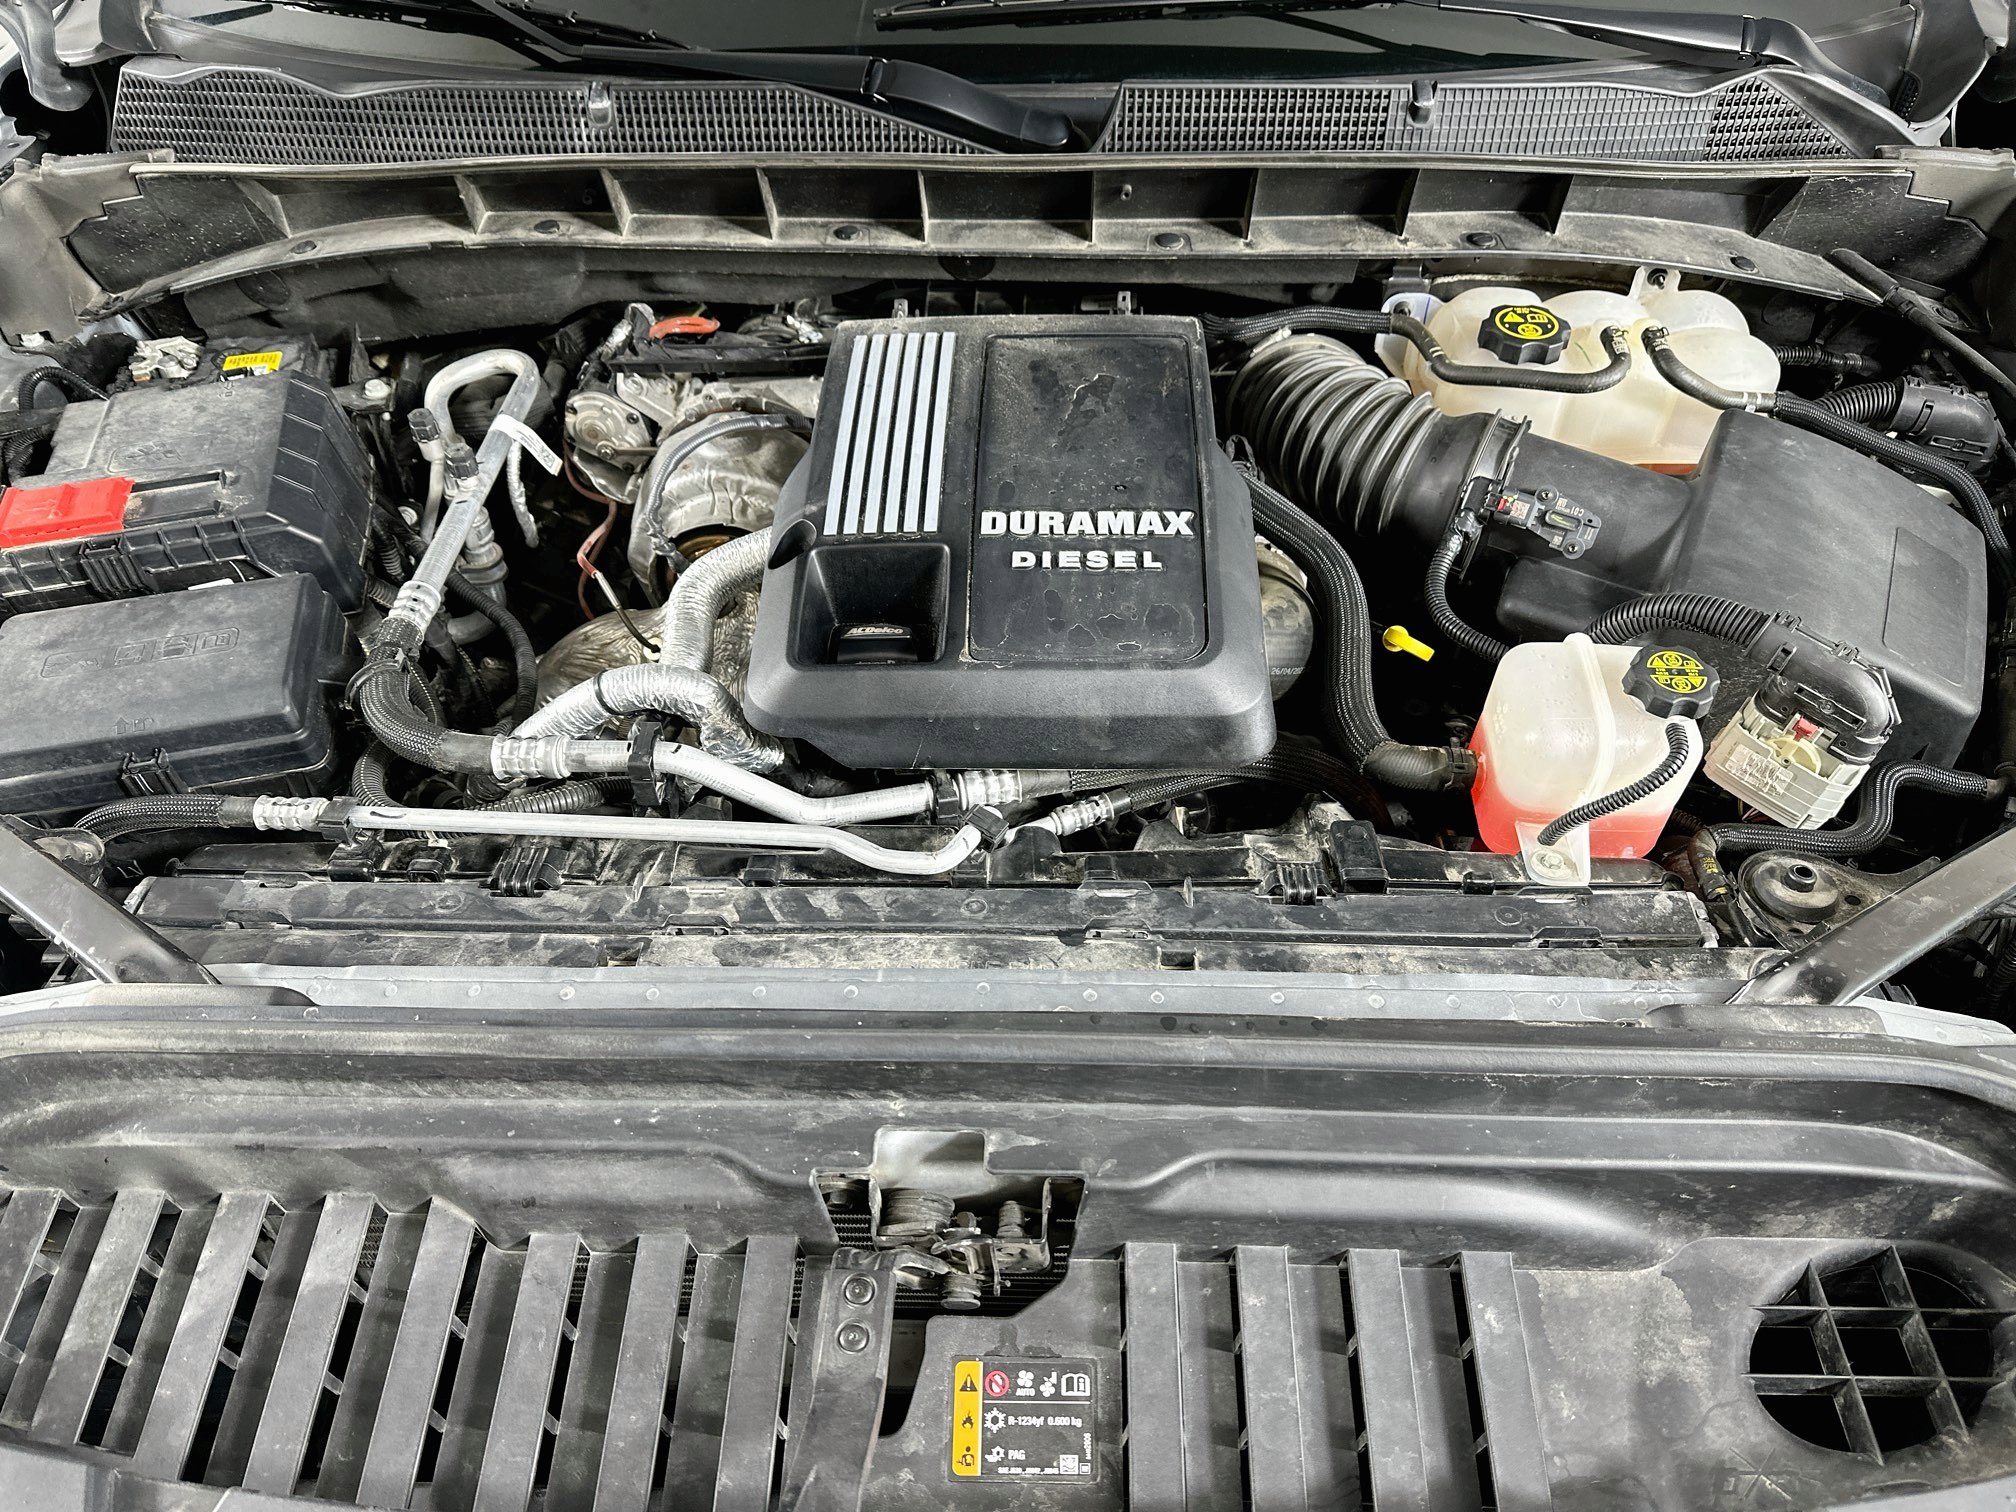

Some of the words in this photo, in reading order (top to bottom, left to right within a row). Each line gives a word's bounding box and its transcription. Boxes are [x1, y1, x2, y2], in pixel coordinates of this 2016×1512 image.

[980, 510, 1195, 537] DURAMAX
[1011, 550, 1163, 571] DIESEL
[846, 626, 904, 635] ACDelco
[1016, 1388, 1035, 1397] AUTO
[1008, 1416, 1044, 1428] R-1234yf
[1071, 1416, 1082, 1428] kg
[1008, 1450, 1026, 1460] PAG
